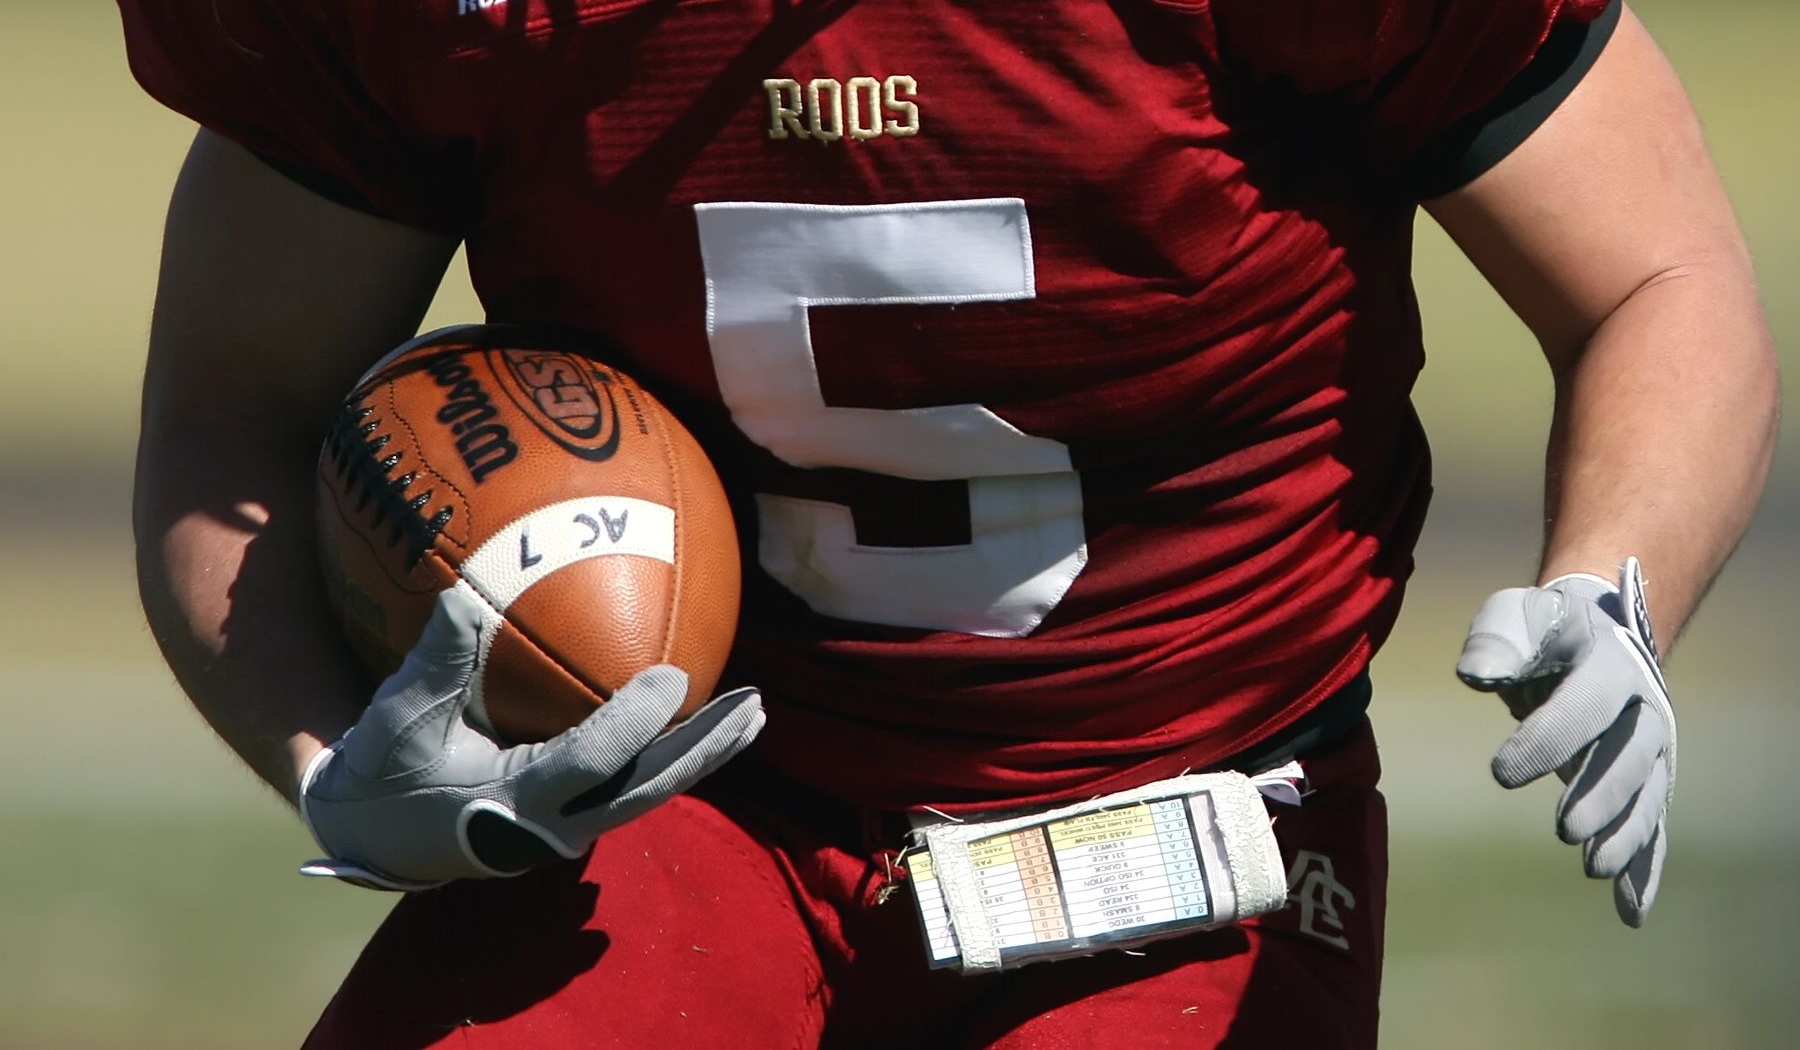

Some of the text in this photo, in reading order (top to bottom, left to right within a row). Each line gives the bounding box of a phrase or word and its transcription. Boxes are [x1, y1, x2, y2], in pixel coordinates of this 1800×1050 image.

[763, 75, 920, 140] ROOS
[430, 350, 518, 484] Wilson
[694, 198, 1088, 638] 5
[573, 507, 629, 548] AC
[1160, 812, 1168, 820] A
[1108, 829, 1132, 838] PASS
[1165, 832, 1173, 840] A
[1073, 835, 1096, 845] NOW
[1087, 842, 1117, 852] SWEEP
[1091, 854, 1109, 862] ACE
[1170, 852, 1178, 860] A
[1025, 858, 1033, 866] B
[1028, 868, 1035, 876] B
[1093, 862, 1122, 873] QUICK
[1083, 874, 1116, 886] OPTION
[1117, 871, 1132, 880] ISO
[1176, 873, 1184, 881] A
[1030, 877, 1038, 885] B
[1033, 887, 1040, 895] B
[1102, 885, 1118, 894] ISO
[1178, 884, 1186, 892] A
[1035, 898, 1043, 906] B
[1098, 896, 1122, 907] READ
[1181, 895, 1189, 904] A
[1038, 908, 1046, 917] B
[1183, 907, 1192, 916] A
[1041, 920, 1048, 929] B
